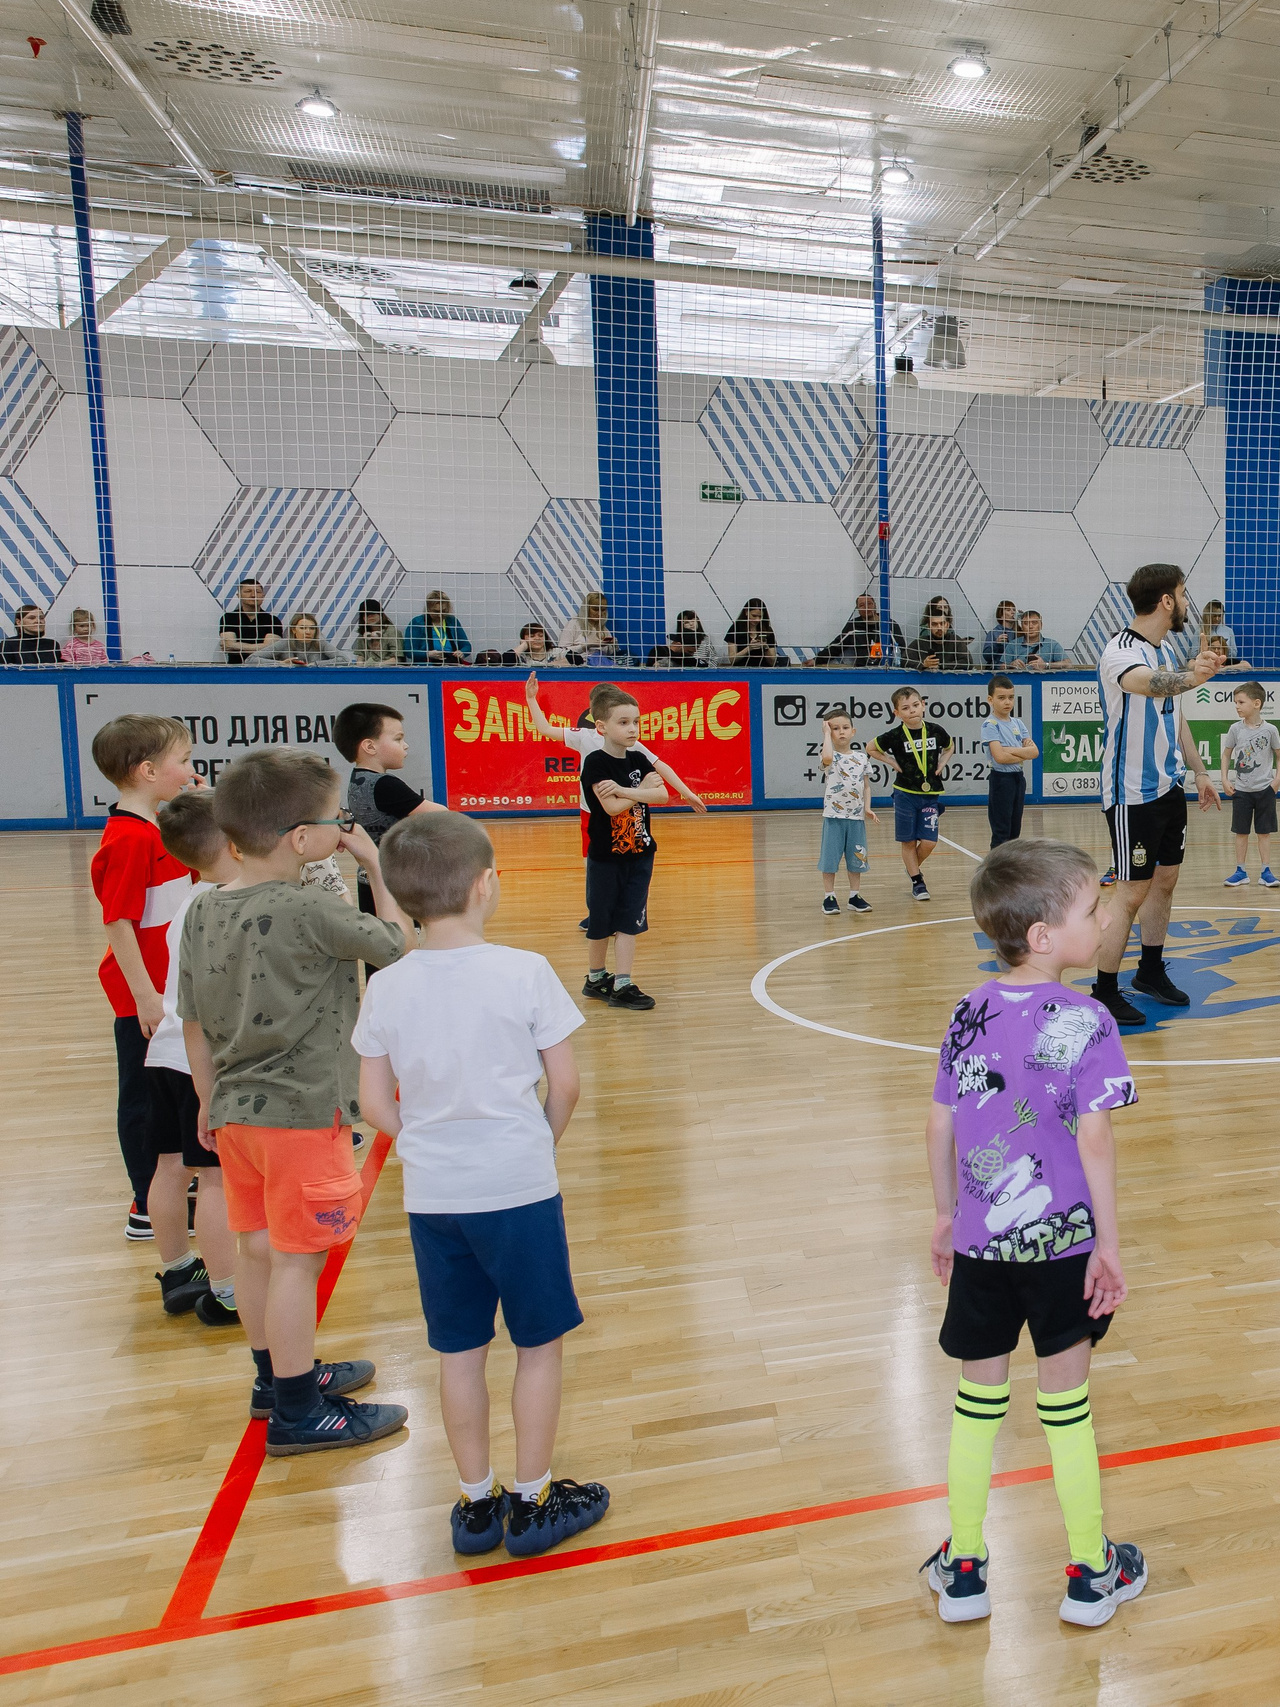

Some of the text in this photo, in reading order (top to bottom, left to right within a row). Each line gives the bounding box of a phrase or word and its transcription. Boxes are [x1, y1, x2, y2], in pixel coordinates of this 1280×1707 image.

[1050, 686, 1098, 697] промок
[1051, 702, 1102, 714] #ZАБЕ
[637, 688, 742, 741] ЕРВИС
[227, 715, 289, 747] ДЛЯ
[295, 715, 336, 743] ВА
[1071, 778, 1100, 790] (383)
[460, 795, 533, 806] 209-50-89
[546, 795, 566, 804] НА
